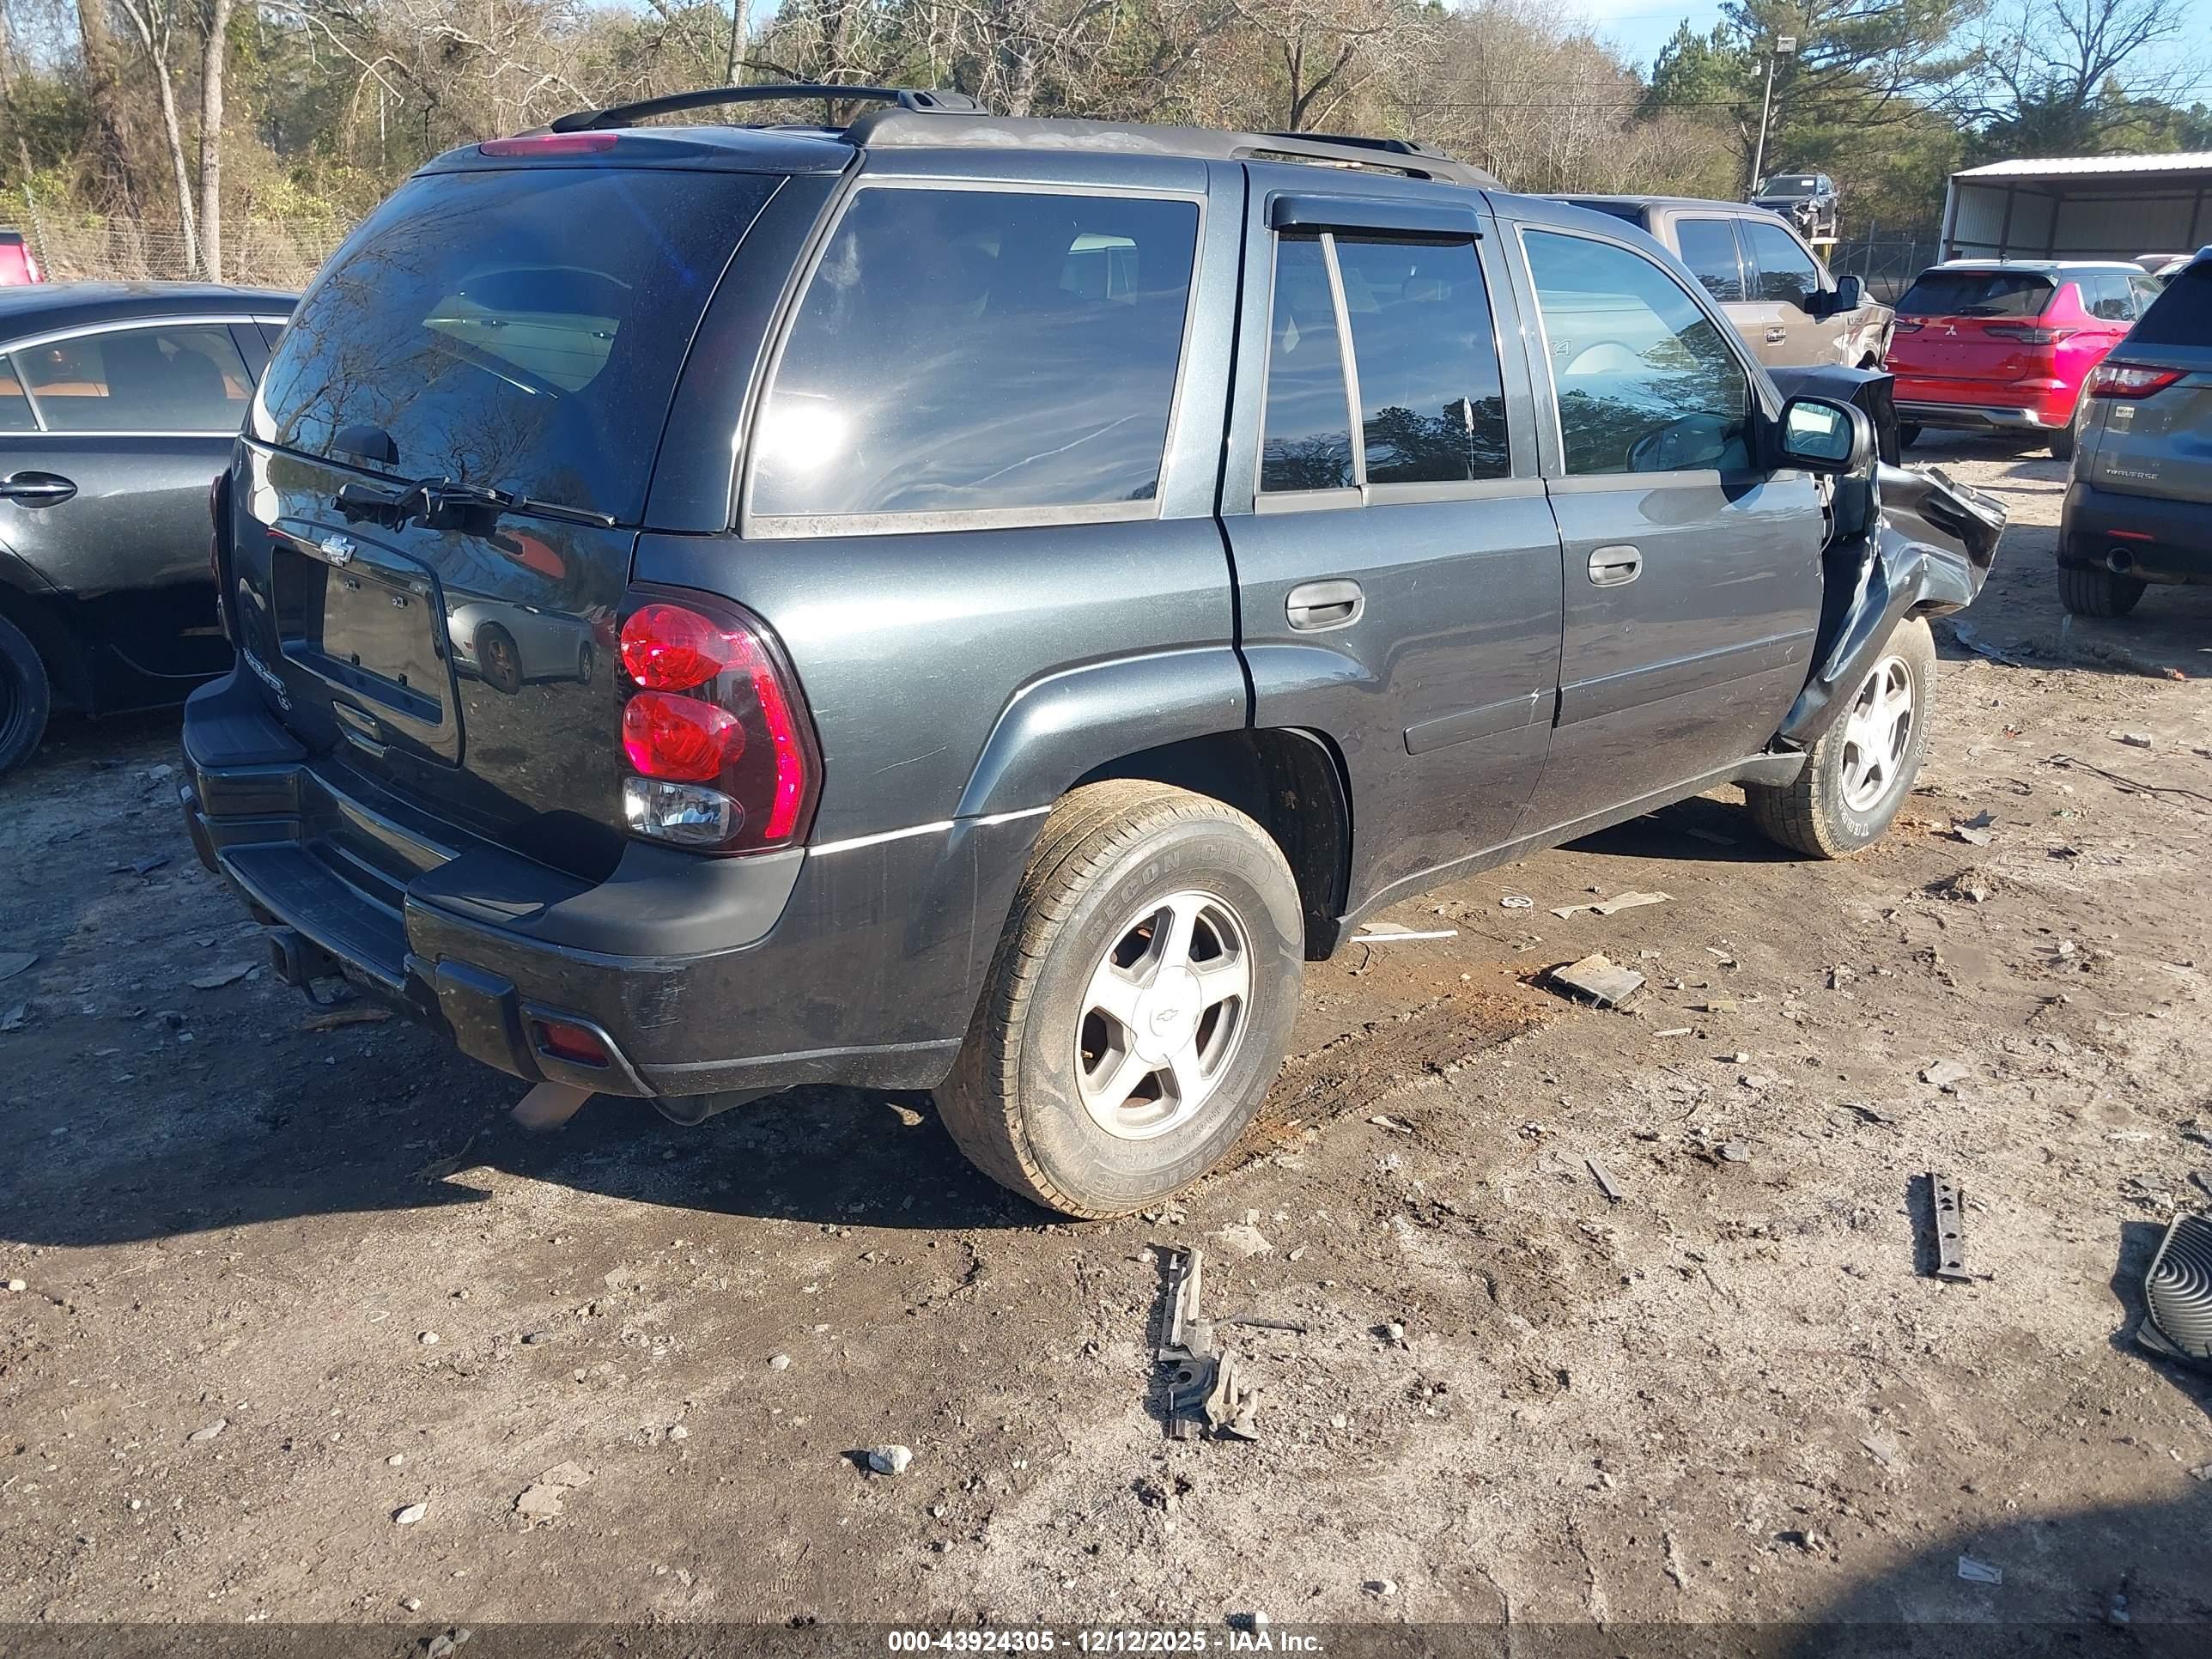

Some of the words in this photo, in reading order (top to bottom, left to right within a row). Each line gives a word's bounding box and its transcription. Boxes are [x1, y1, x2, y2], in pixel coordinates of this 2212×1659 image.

[2105, 469, 2160, 481] TRAVERSE
[1913, 659, 1934, 760] SAILUN
[1199, 842, 1255, 870] CUV
